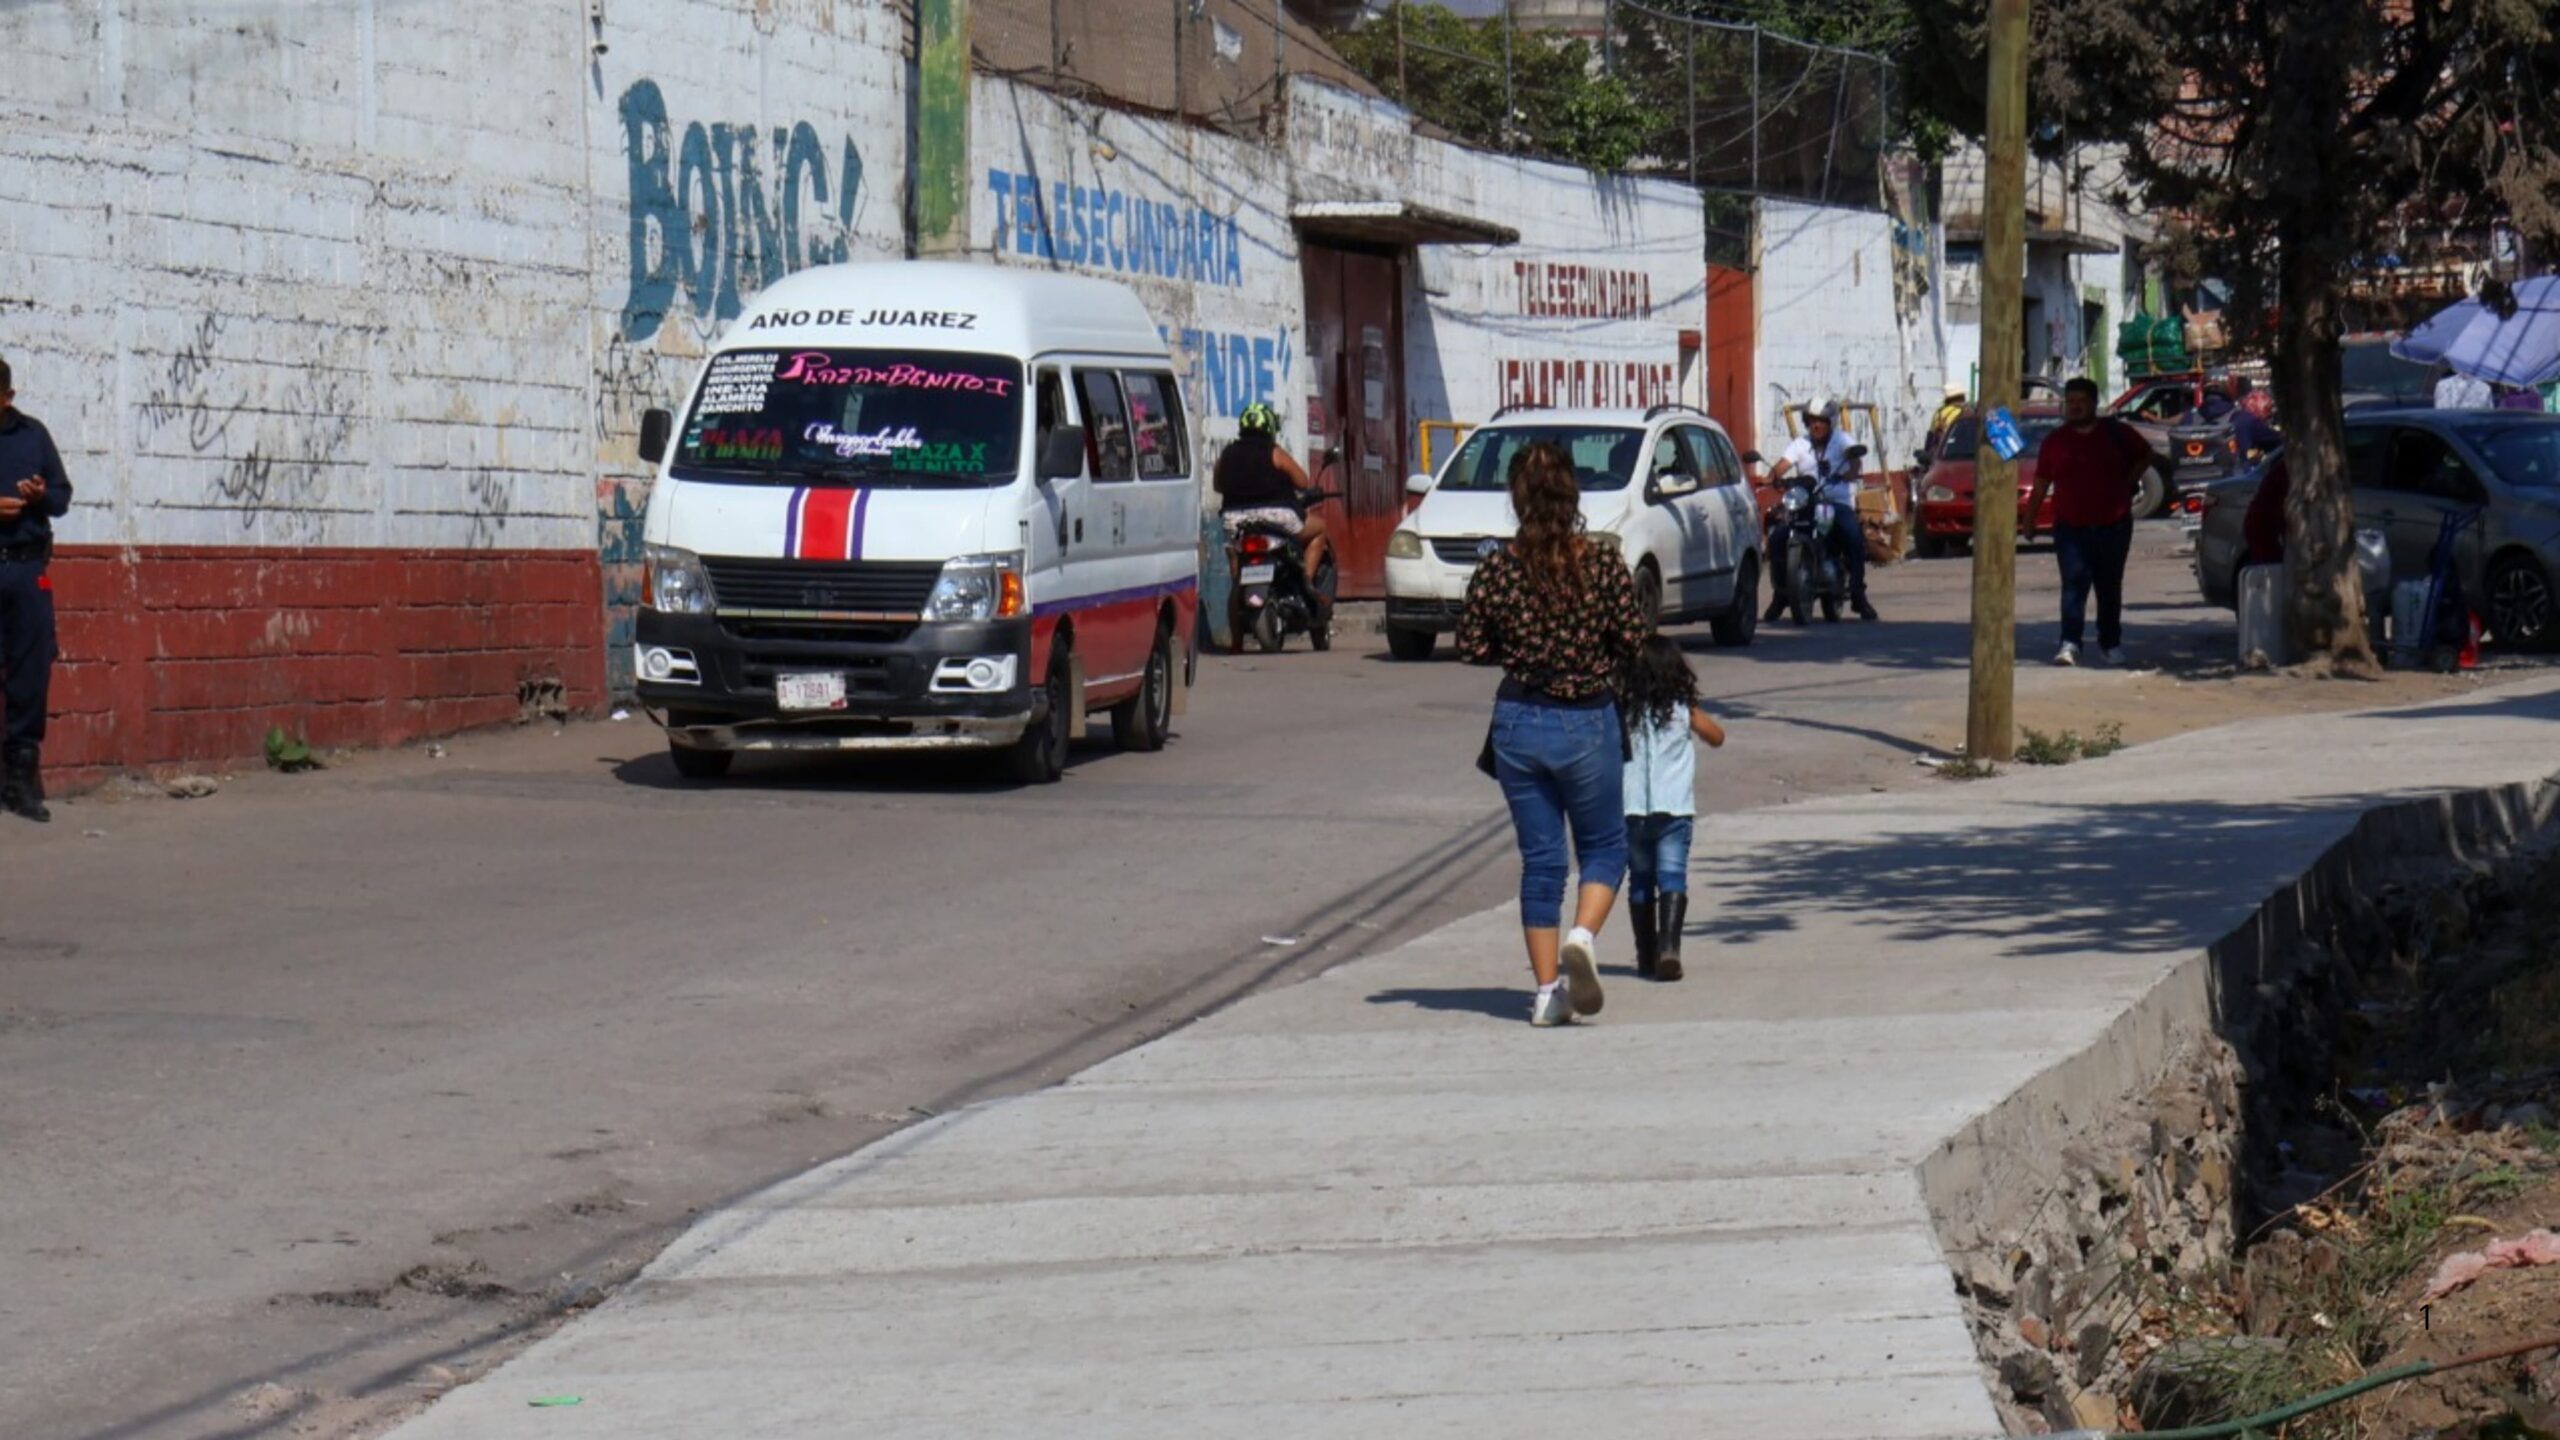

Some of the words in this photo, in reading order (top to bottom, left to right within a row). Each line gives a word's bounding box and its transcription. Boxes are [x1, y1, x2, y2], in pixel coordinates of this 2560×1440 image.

[988, 168, 1243, 287] TELESECUNDARIA
[1514, 261, 1651, 321] TELESECUNDARIA
[749, 309, 810, 330] AÑO
[816, 310, 854, 325] DE
[860, 311, 978, 329] JUAREZ
[704, 384, 768, 395] INE-VIA
[701, 394, 765, 404] ALAMEDA
[697, 403, 764, 413] RANCHITO
